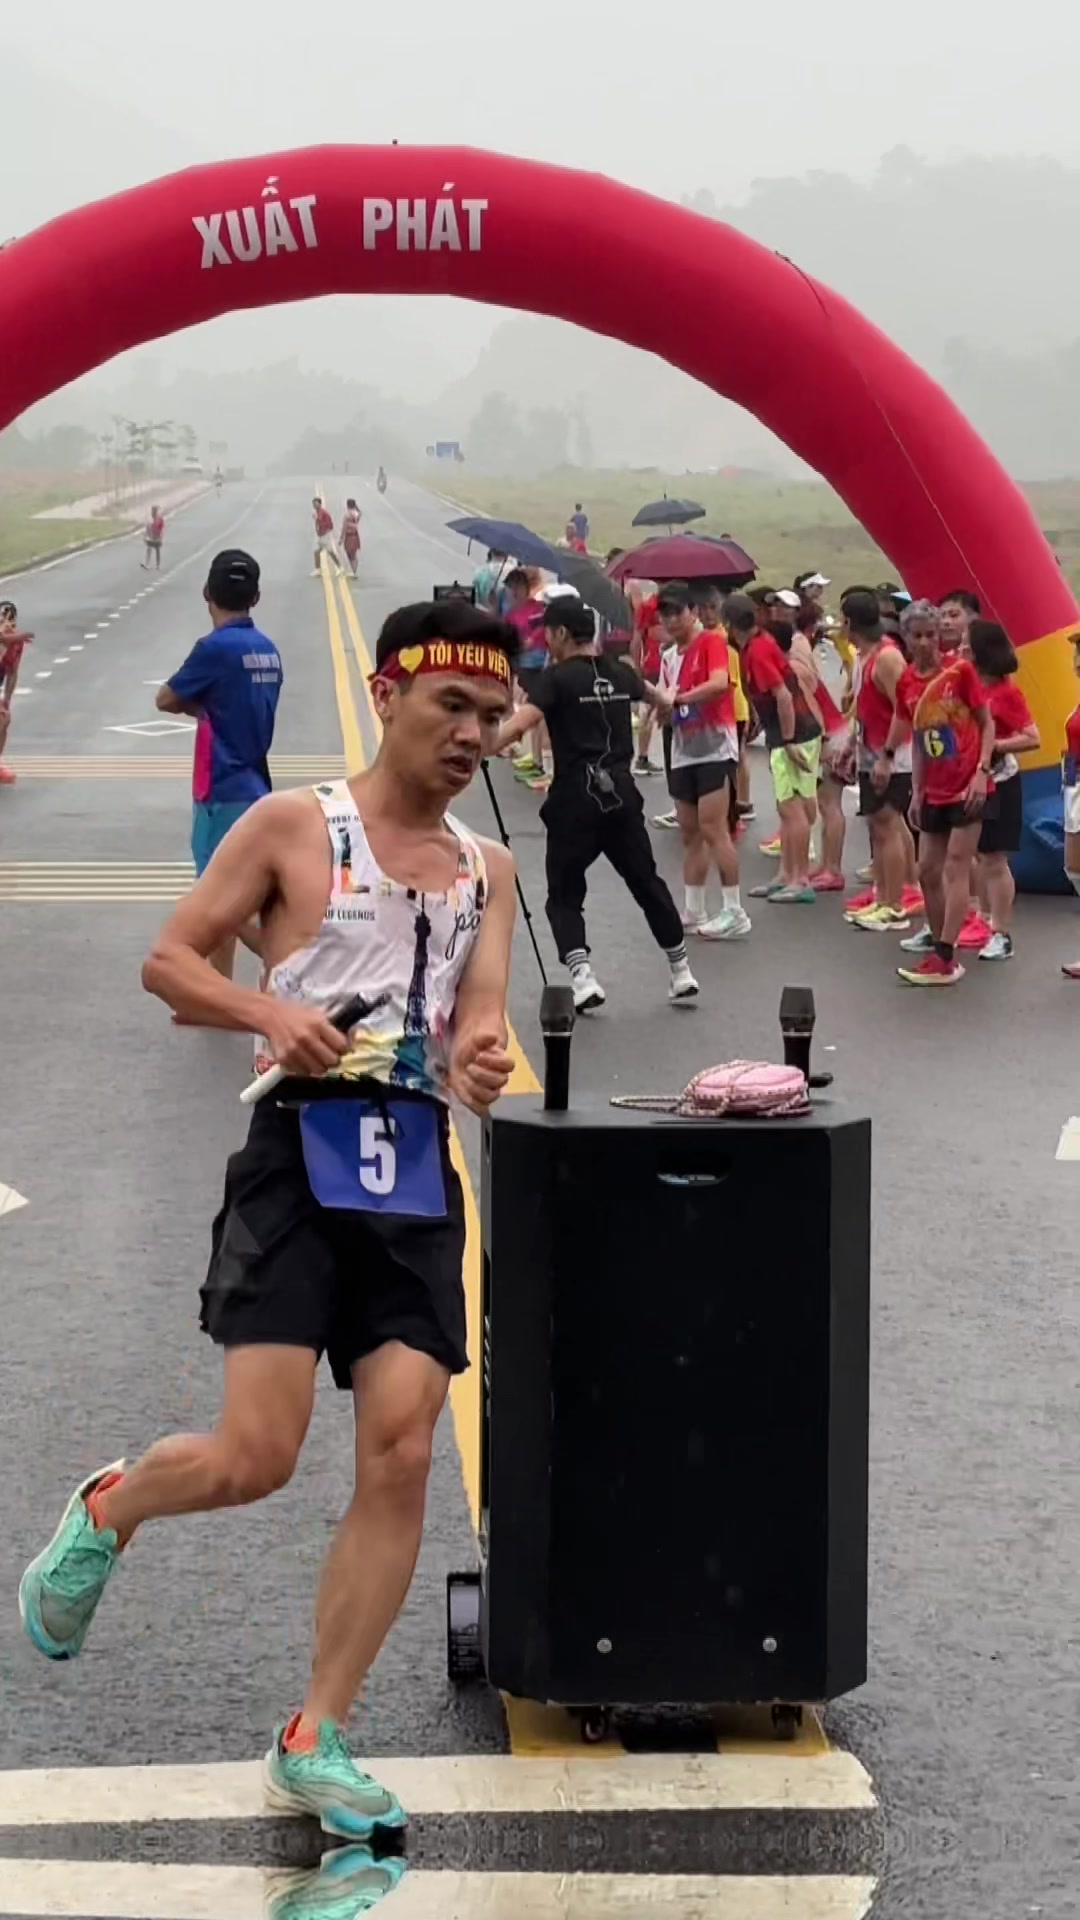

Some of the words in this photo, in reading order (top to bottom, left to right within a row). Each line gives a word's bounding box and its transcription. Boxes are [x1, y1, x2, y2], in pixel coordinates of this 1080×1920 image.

[192, 176, 318, 268] XUẤT
[363, 182, 488, 251] PHÁT
[428, 641, 452, 665] TÔI
[456, 641, 484, 666] YÊU
[924, 729, 945, 758] 6
[360, 1117, 396, 1194] 5
